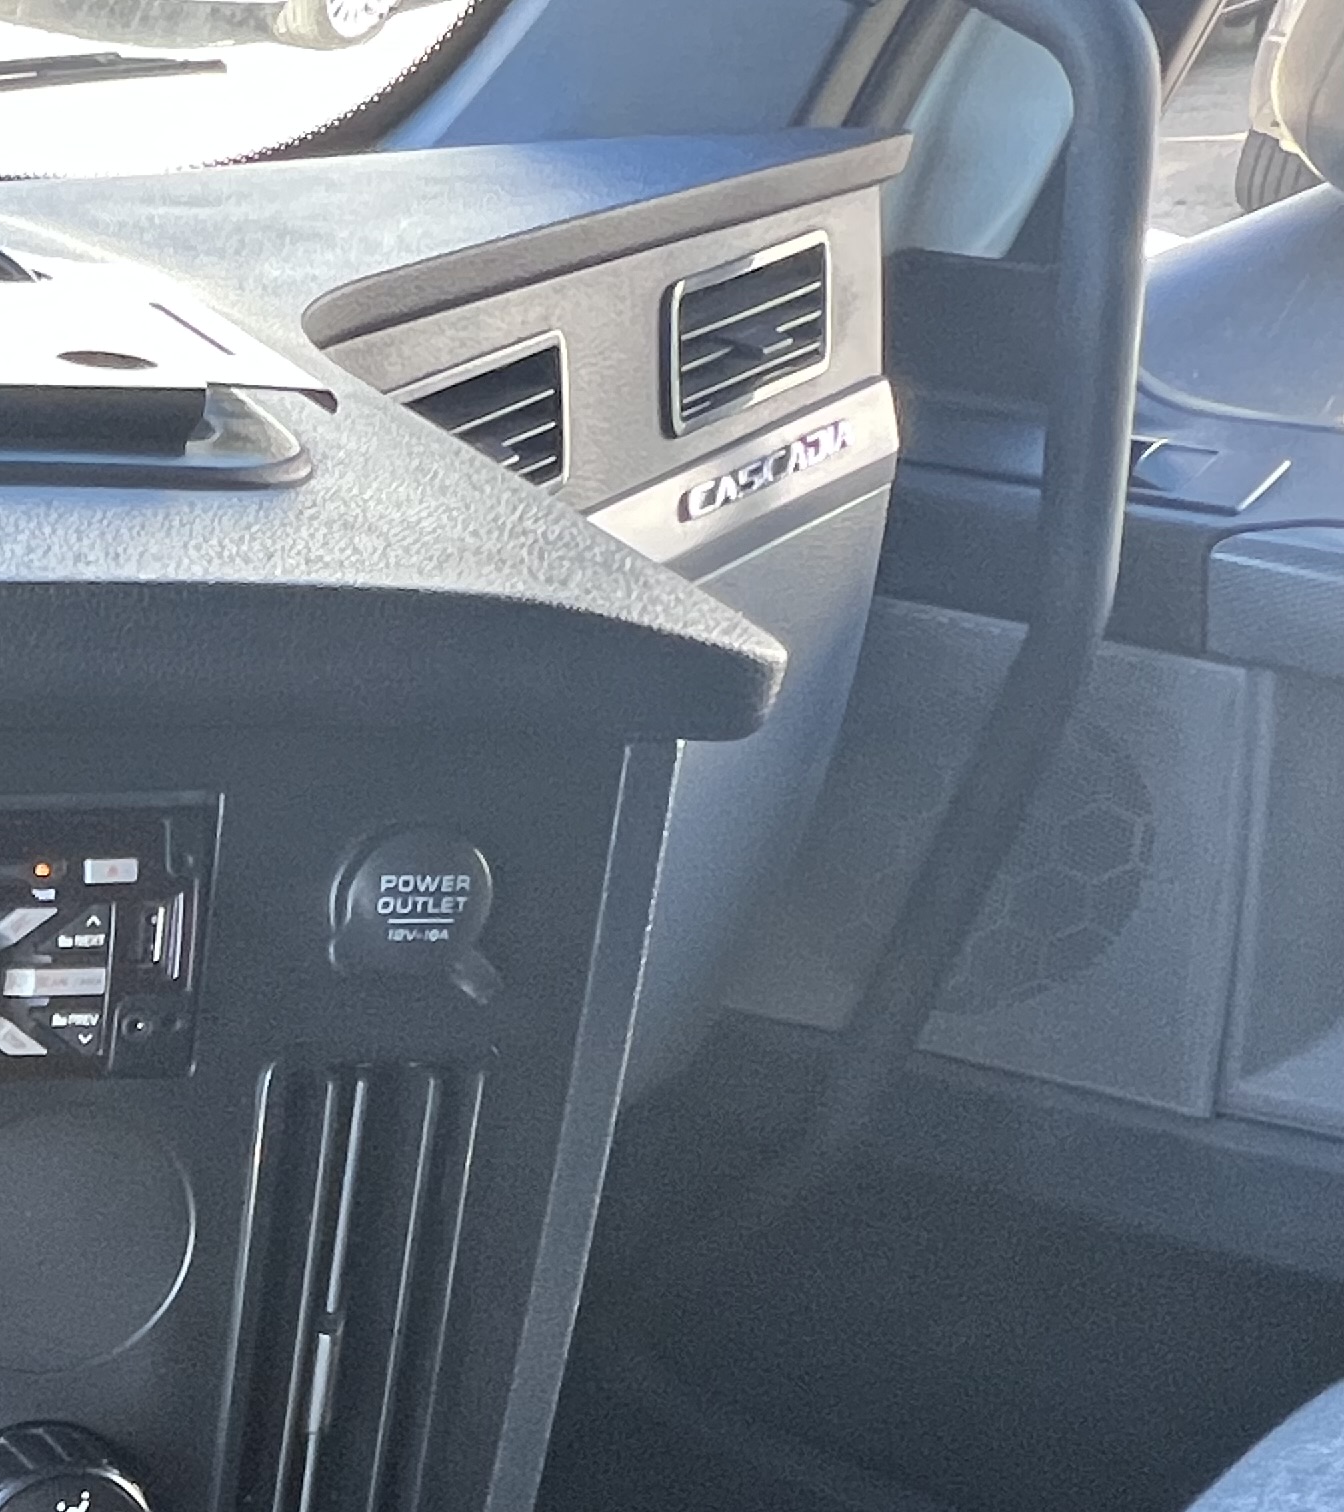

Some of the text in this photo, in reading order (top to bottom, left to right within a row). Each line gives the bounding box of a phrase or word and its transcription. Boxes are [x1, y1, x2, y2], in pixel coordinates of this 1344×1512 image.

[679, 418, 854, 522] CASCADIA
[380, 874, 470, 893] POWER
[376, 896, 469, 914] OUTLET
